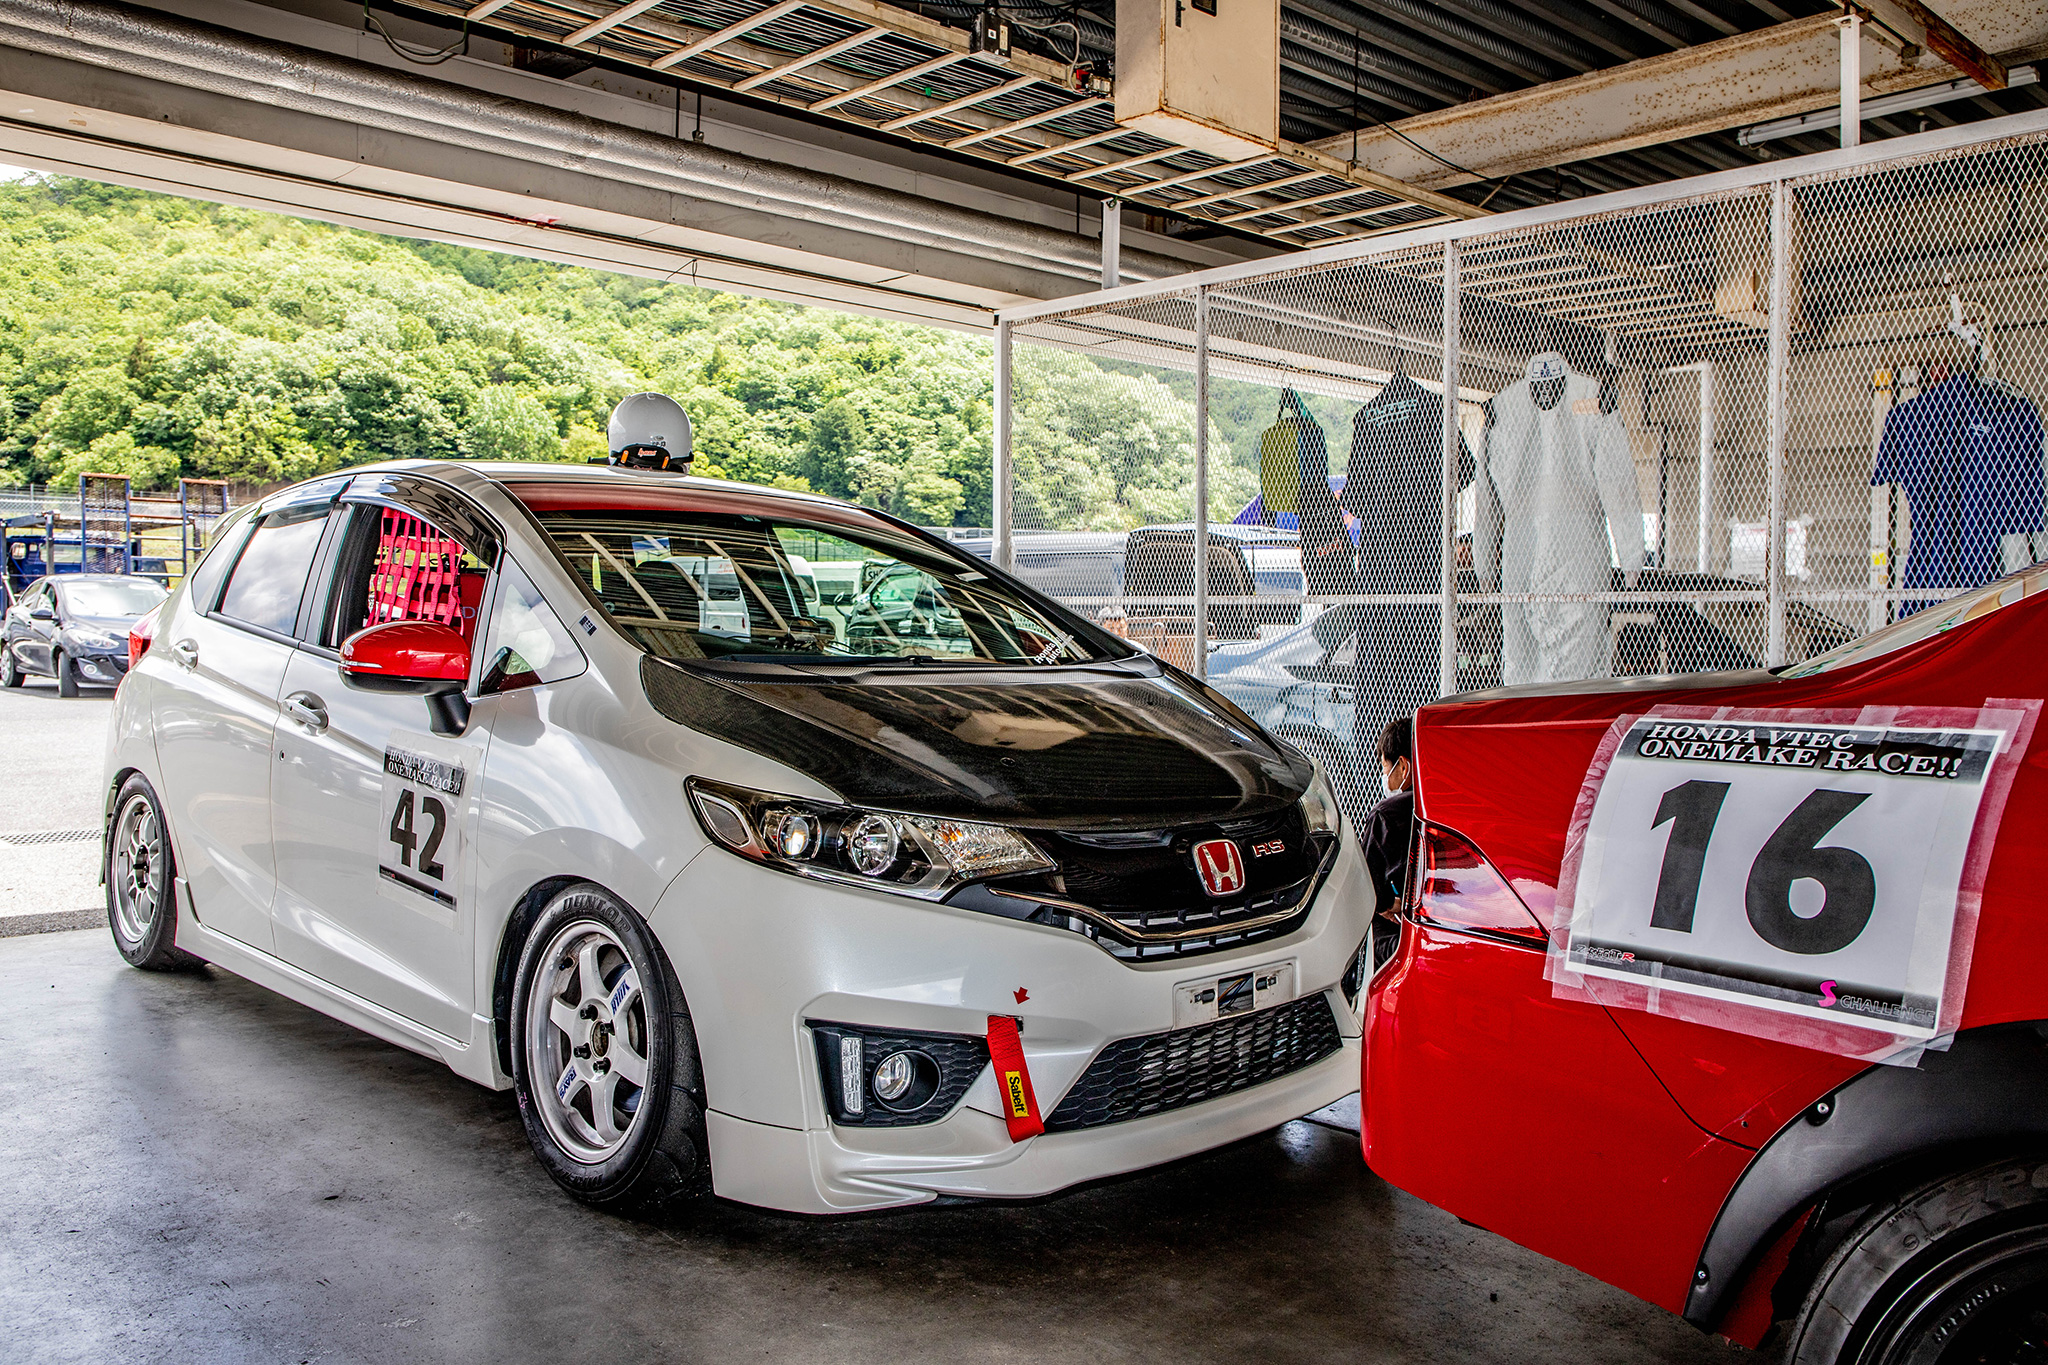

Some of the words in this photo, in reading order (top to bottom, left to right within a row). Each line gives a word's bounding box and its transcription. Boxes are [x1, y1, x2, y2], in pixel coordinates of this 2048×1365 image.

[1647, 724, 1757, 743] HONDA
[1769, 729, 1859, 750] VTEC
[388, 761, 430, 784] ONEMAKE
[389, 749, 416, 768] HONDA
[1640, 739, 1819, 767] ONEMAKE
[1824, 750, 1964, 778] RACE!!
[389, 788, 447, 882] 42
[1252, 839, 1286, 858] RS
[1650, 780, 1876, 955] 16
[562, 893, 632, 933] DUNLOP
[1840, 995, 1936, 1024] CHALLENGE
[558, 1069, 577, 1099] RAYS
[1009, 1076, 1026, 1113] Sabelt
